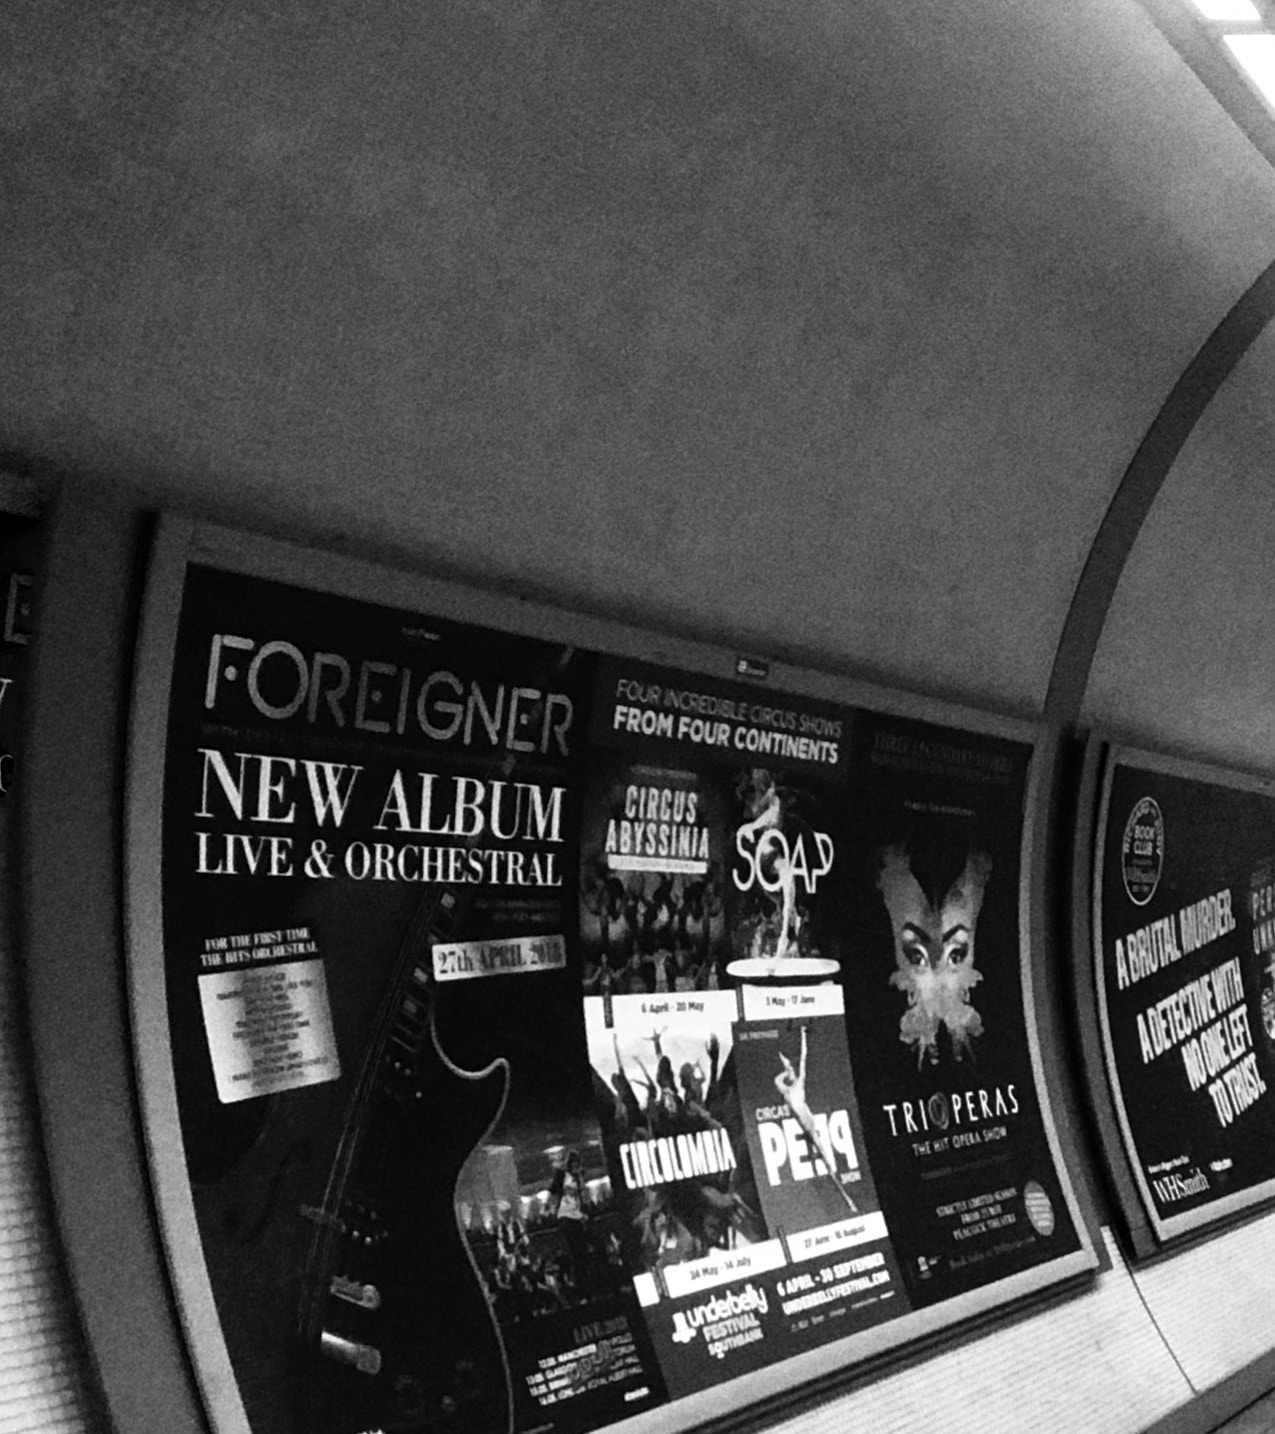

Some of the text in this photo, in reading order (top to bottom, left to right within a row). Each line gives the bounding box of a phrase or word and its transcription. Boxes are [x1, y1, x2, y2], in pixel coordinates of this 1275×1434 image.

[203, 633, 574, 757] FOREIGNER
[616, 678, 842, 738] FOUR INCREDIBLE CIRCUS SHOWS
[613, 704, 839, 765] FROM FOUR CONTINENTS
[194, 747, 367, 828] NEW
[372, 768, 568, 843] ALBUM
[623, 784, 699, 825] CIRCUS
[194, 831, 295, 878] LIVE
[303, 838, 336, 880] &
[343, 840, 564, 887] ORCHESTRAL
[604, 818, 710, 860] ABYSSINIA
[731, 826, 835, 895] SOAP
[1133, 840, 1154, 857] CLUB
[438, 948, 474, 974] 27th
[479, 943, 526, 970] APRIL
[1115, 937, 1131, 991] A
[1126, 912, 1184, 984] BRUTAL
[1179, 887, 1237, 956] MURDER.
[1136, 956, 1246, 1065] A DETECTIVE WITH
[1180, 1002, 1254, 1092] NO ONE LEFT
[882, 1082, 1020, 1138] TRIOPERAS
[1208, 1051, 1268, 1128] TO TRUST.
[911, 1125, 1007, 1157] THE HIT OPERA SHOW
[1151, 1166, 1211, 1204] WHSmith
[686, 1282, 769, 1328] underbelly
[785, 1271, 815, 1293] APRIL
[702, 1312, 760, 1343] FESTIVAL
